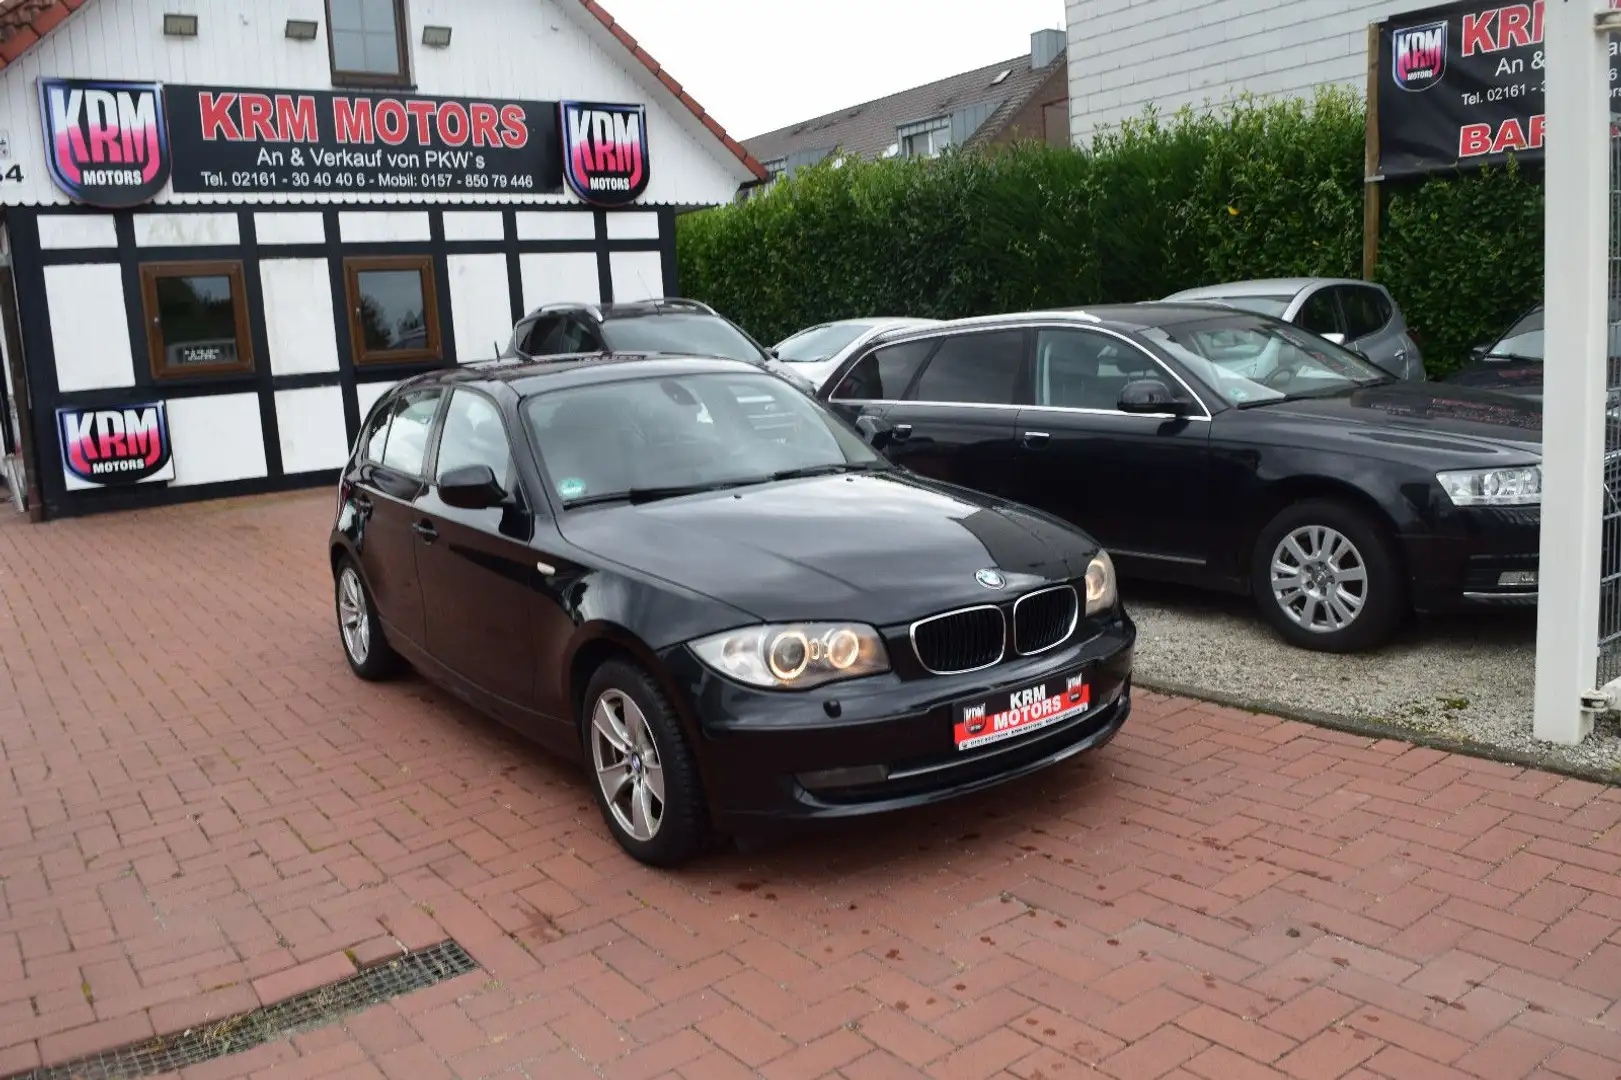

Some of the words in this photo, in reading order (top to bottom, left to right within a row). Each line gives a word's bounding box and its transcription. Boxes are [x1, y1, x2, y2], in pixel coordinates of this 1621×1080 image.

[1398, 28, 1442, 80] KRM
[1495, 56, 1524, 77] An
[1531, 50, 1546, 70] &
[1461, 91, 1484, 105] Tel.
[1487, 84, 1526, 101] 02161
[198, 91, 319, 143] KRM
[332, 96, 528, 149] MOTORS
[51, 88, 160, 183] KRM
[256, 146, 284, 167] An
[290, 147, 305, 167] &
[309, 147, 382, 168] Verkauf
[387, 152, 420, 169] von
[569, 110, 643, 189] KRM
[83, 168, 142, 186] MOTORS
[200, 171, 228, 186] Tel.
[232, 171, 277, 187] 02161
[292, 171, 310, 187] 30
[313, 172, 332, 187] 40
[335, 172, 353, 187] 40
[356, 172, 366, 187] 6
[378, 172, 418, 188] Mobil:
[421, 173, 453, 188] 0157
[465, 174, 489, 188] 850
[491, 174, 507, 189] 79
[510, 174, 534, 189] 446
[589, 176, 630, 190] MOTORS
[65, 407, 161, 474] KRM
[92, 457, 145, 474] MOTORS
[1010, 684, 1046, 710] KRM
[994, 695, 1062, 731] MOTORS
